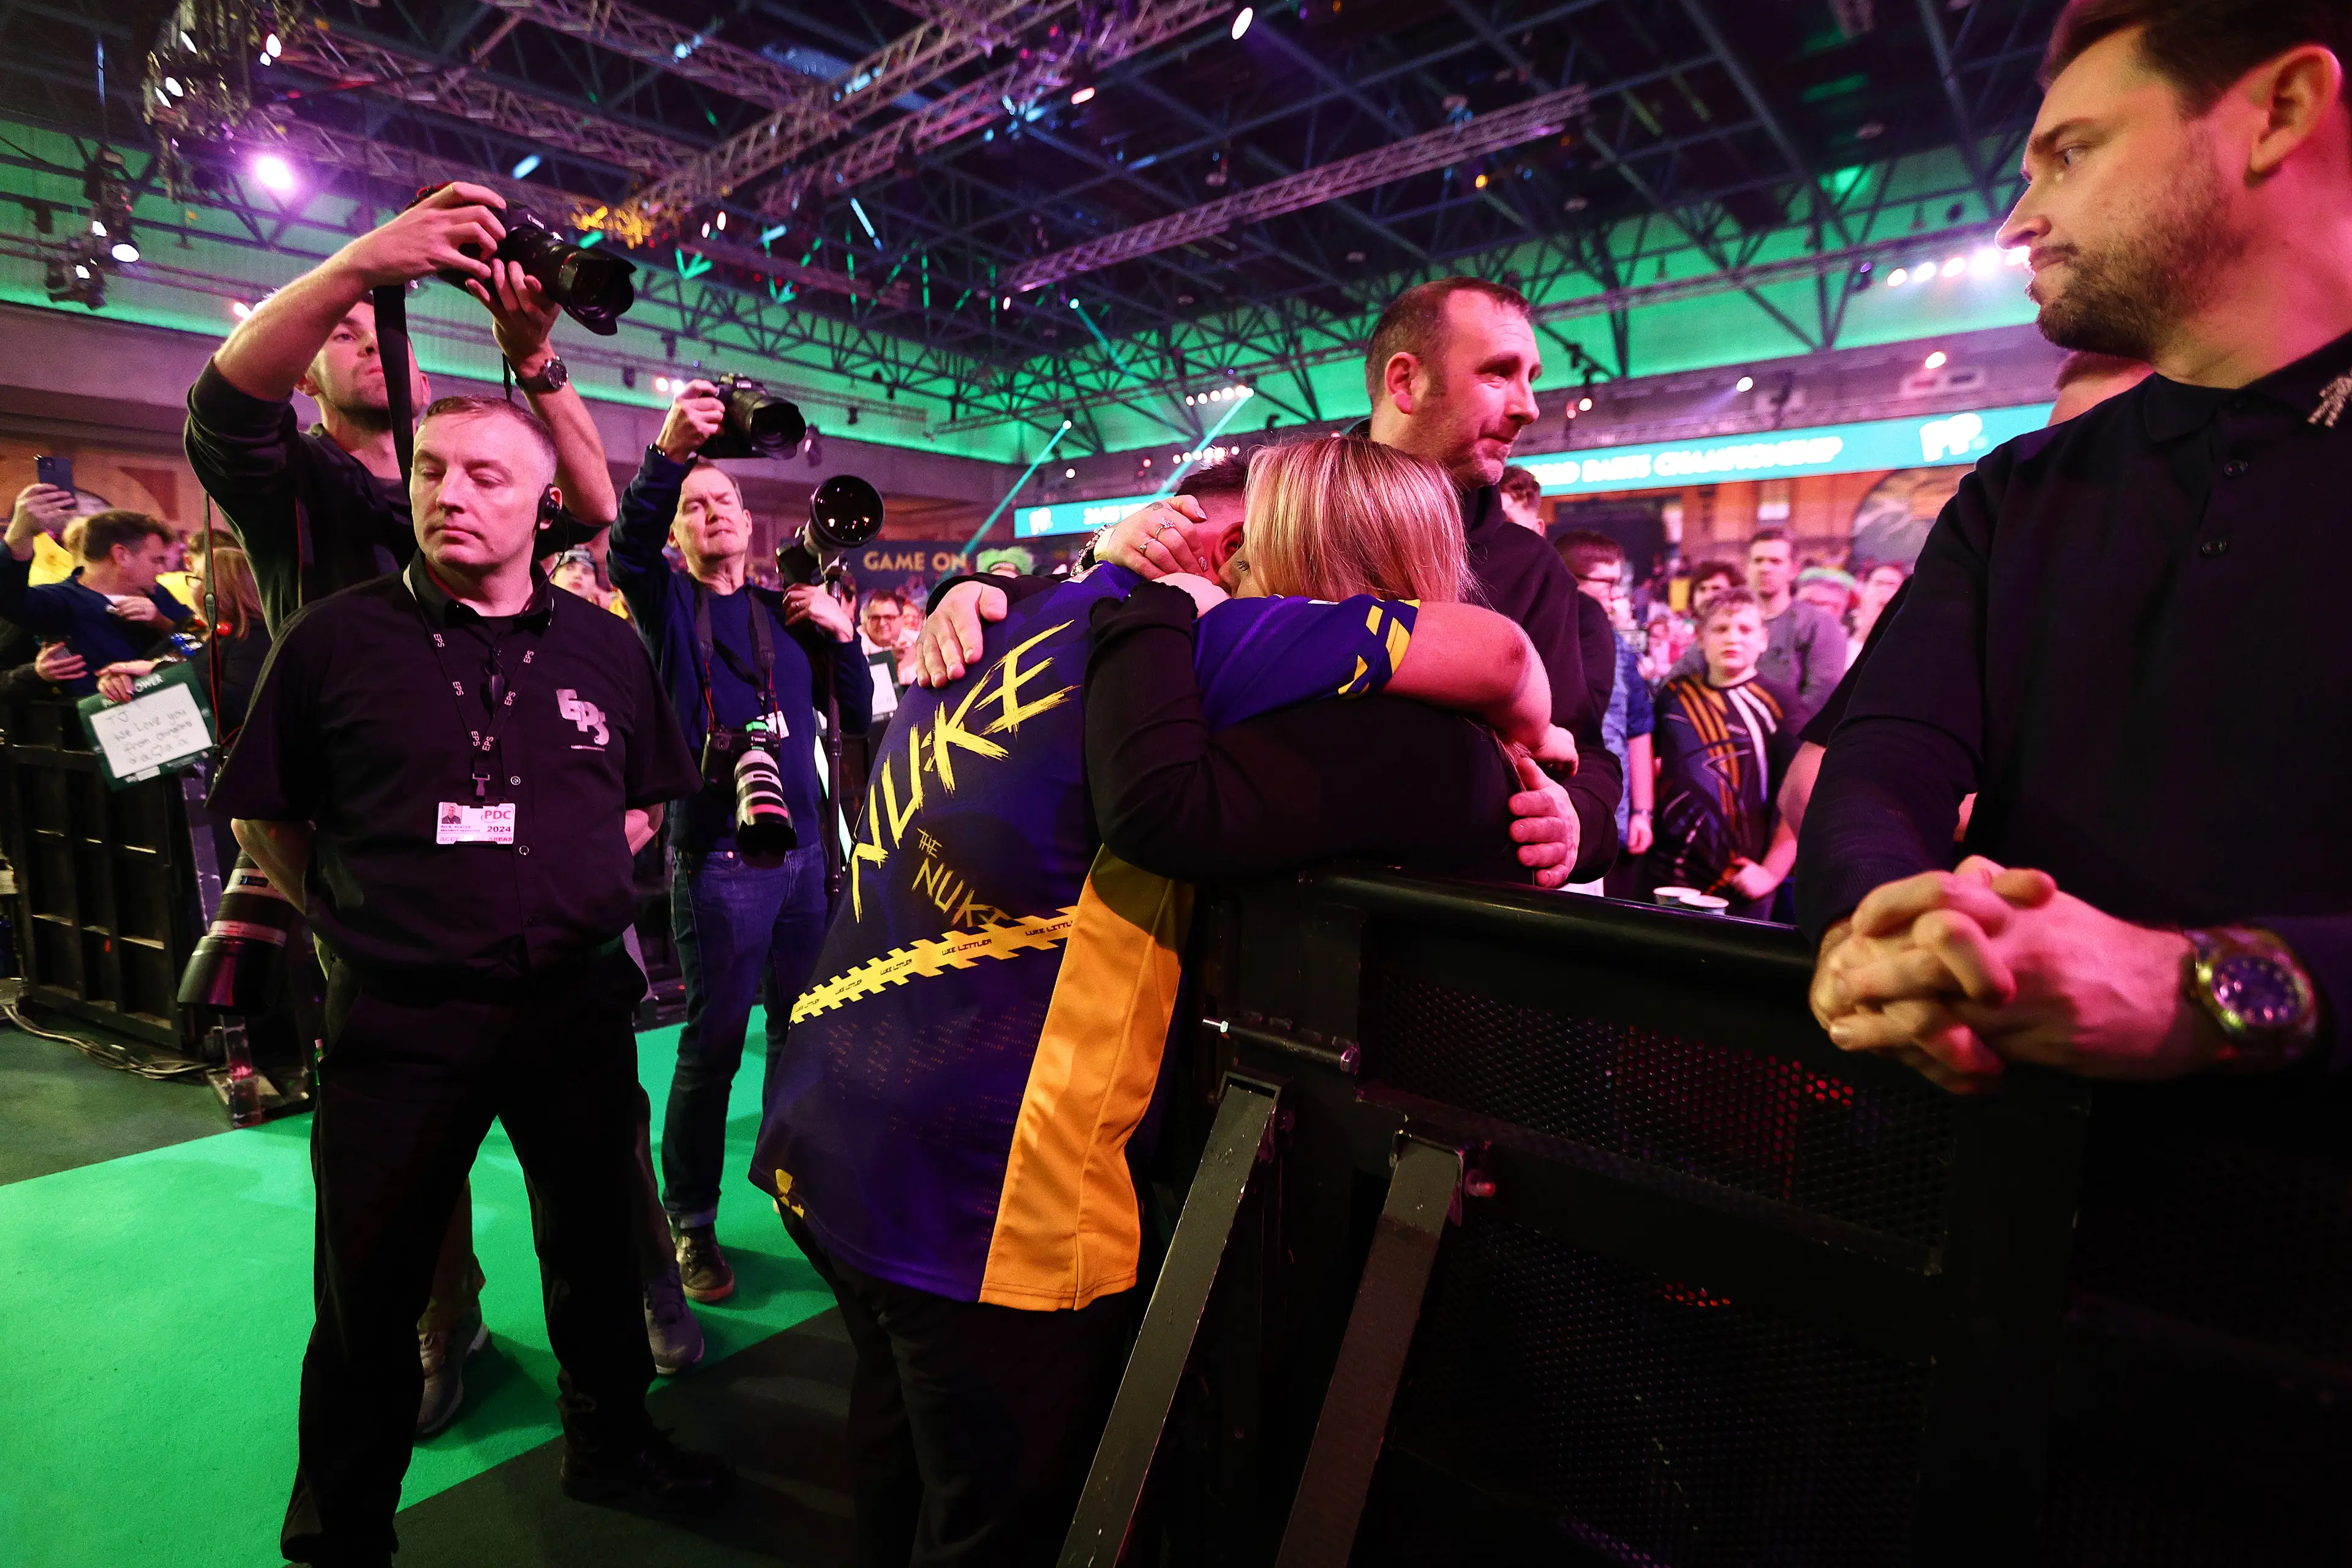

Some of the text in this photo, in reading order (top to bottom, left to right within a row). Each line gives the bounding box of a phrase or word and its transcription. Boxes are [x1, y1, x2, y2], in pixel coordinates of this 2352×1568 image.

[863, 551, 968, 572] GAME ON
[433, 633, 445, 648] EPS
[523, 649, 535, 664] EPS
[452, 681, 464, 696] EPS
[504, 690, 516, 706] EPS
[471, 730, 481, 747] EPS
[481, 736, 494, 752] EPS
[850, 619, 1082, 924] NUKE
[484, 810, 512, 820] PDC
[916, 827, 943, 859] THE
[1025, 928, 1045, 937] LUKE
[941, 938, 992, 956] LUKE LITTLER
[880, 959, 913, 975] LUKE LITTLER
